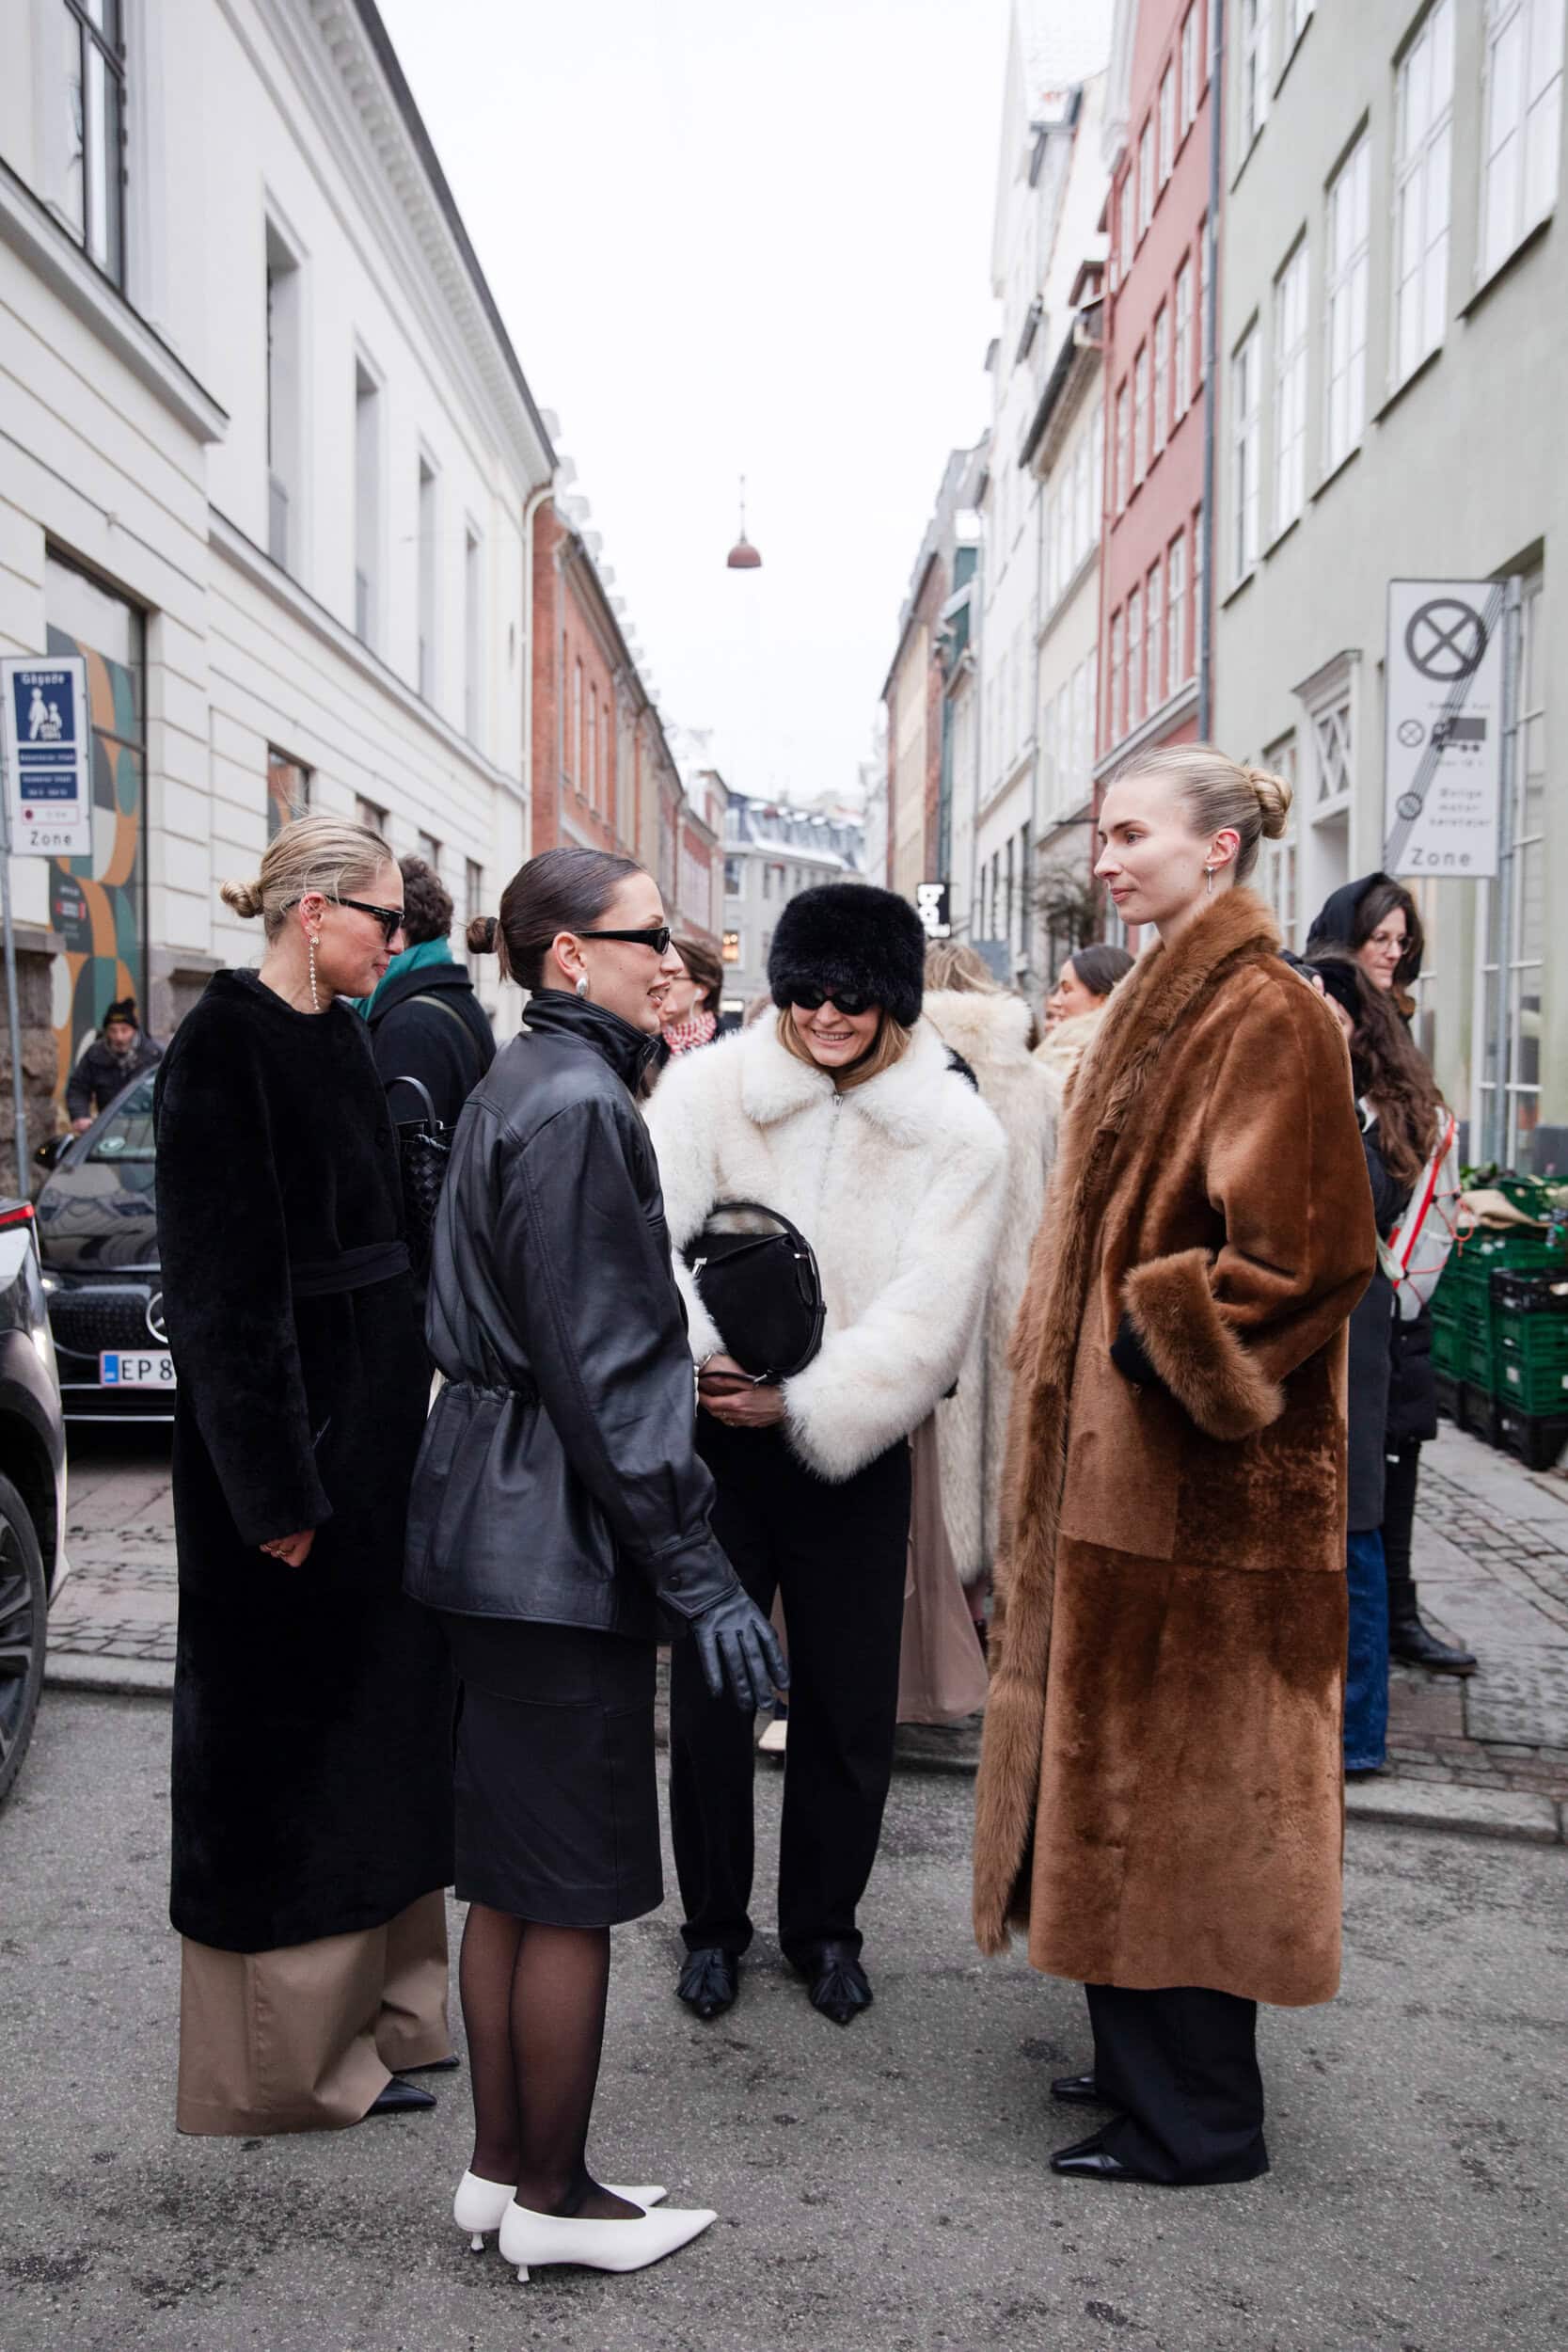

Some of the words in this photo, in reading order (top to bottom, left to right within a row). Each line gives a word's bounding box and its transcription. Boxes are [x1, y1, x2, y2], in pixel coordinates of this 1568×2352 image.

[30, 831, 72, 847] Zone
[1411, 847, 1471, 866] Zone
[121, 1359, 152, 1381] EP
